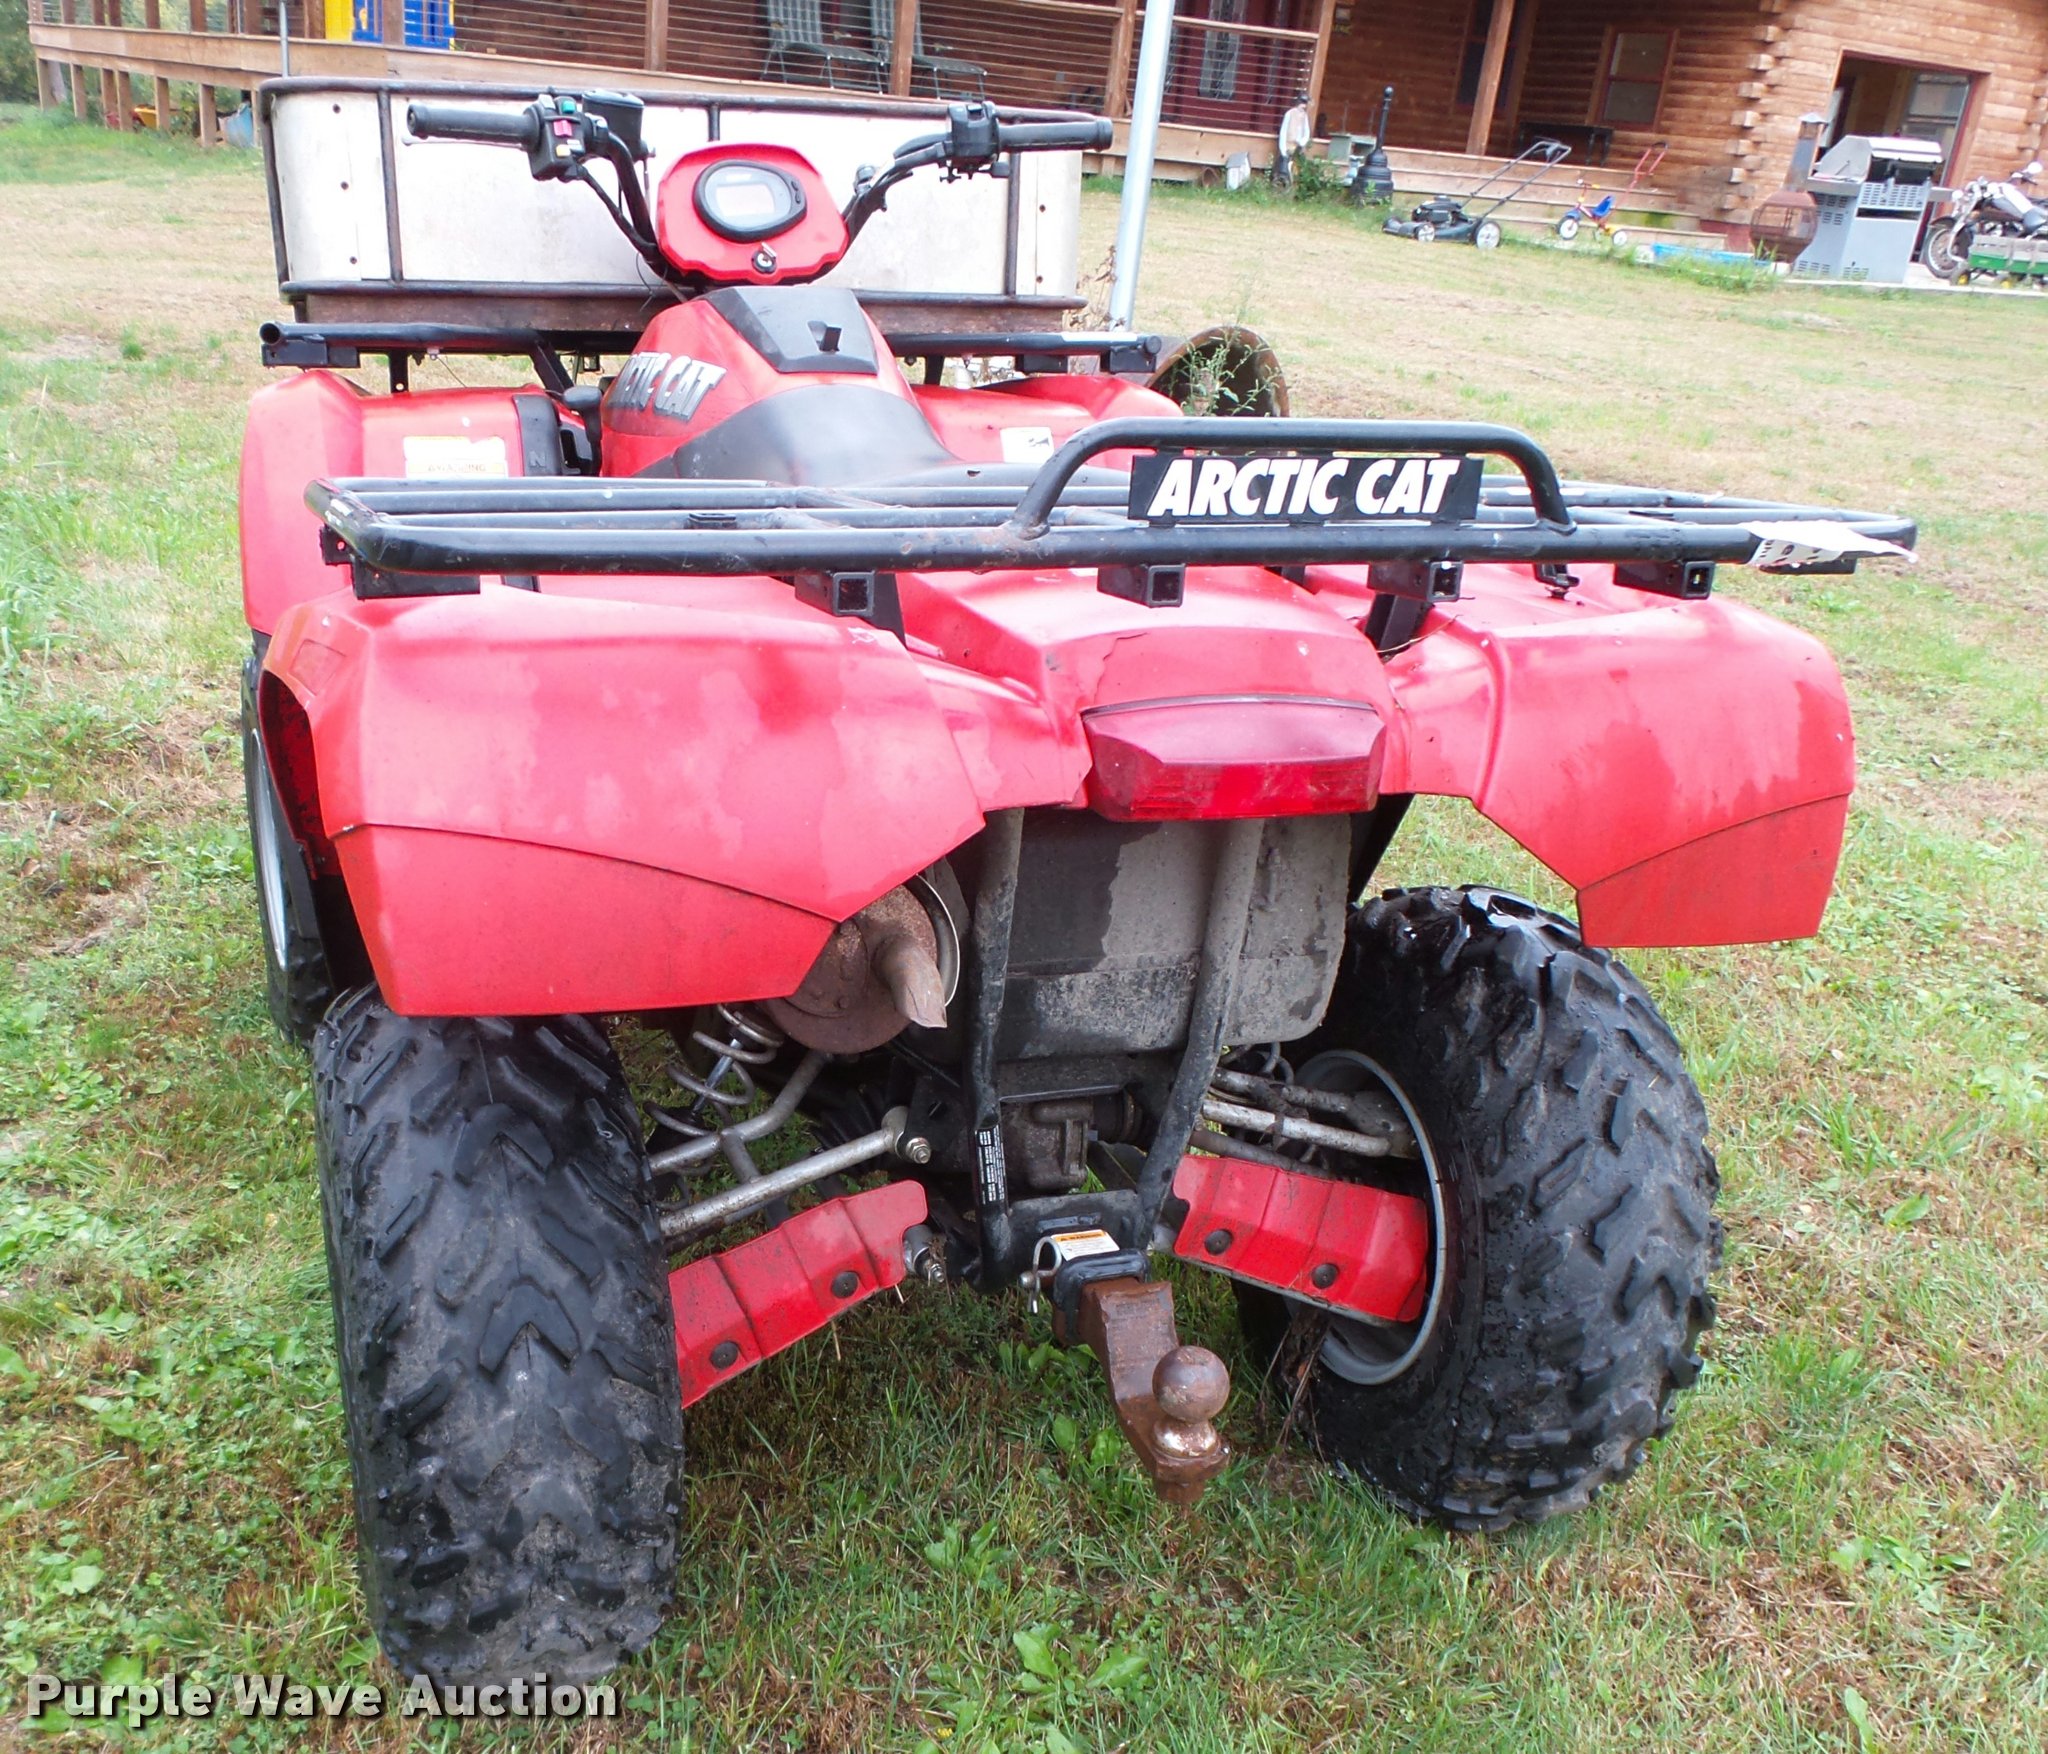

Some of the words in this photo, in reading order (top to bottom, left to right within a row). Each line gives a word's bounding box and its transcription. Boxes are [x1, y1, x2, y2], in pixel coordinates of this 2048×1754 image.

[607, 351, 672, 411] CTIC
[653, 355, 728, 421] CAT
[1147, 458, 1349, 517] ARCTIC
[1355, 458, 1461, 515] CAT
